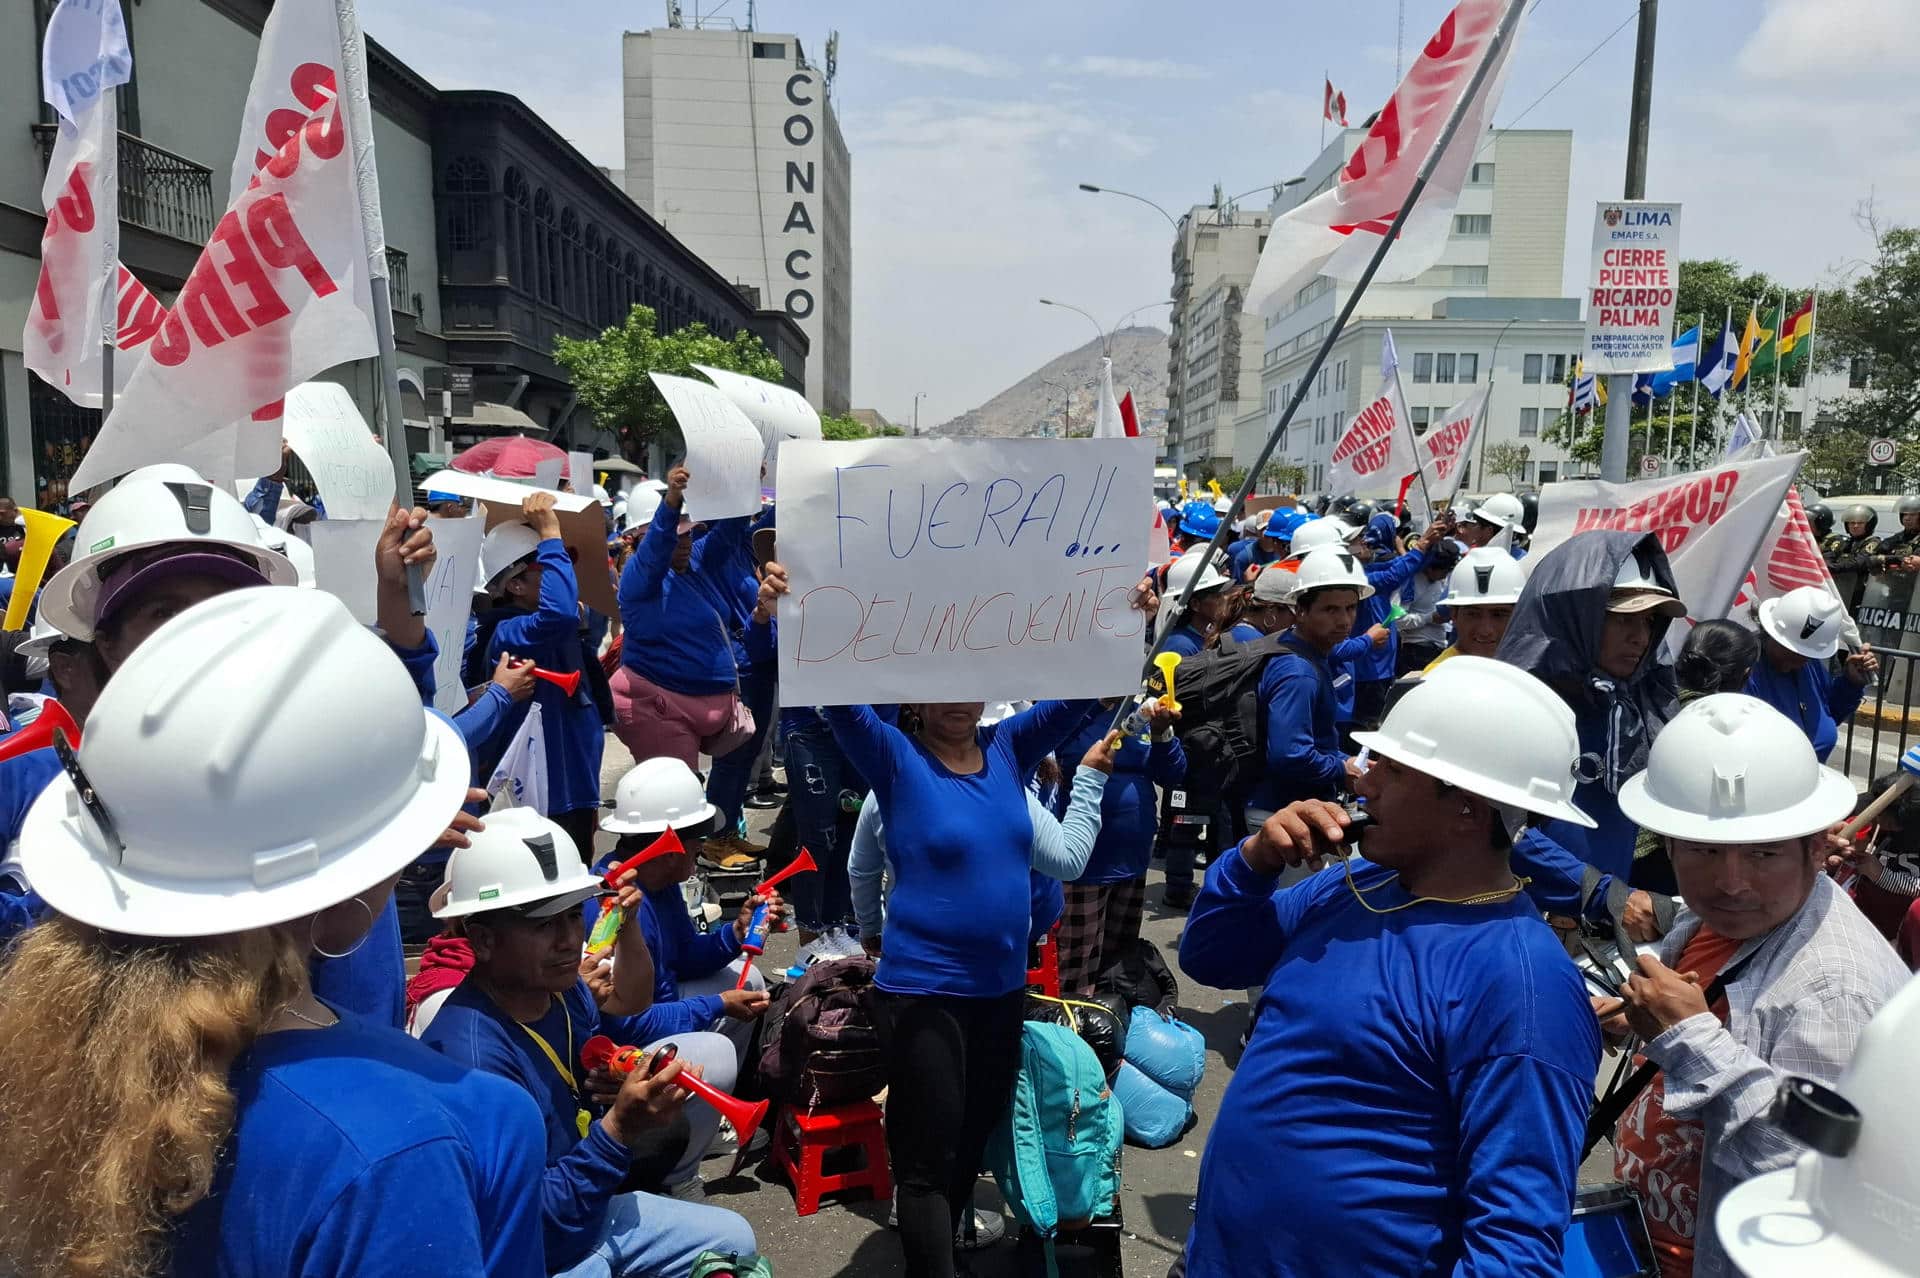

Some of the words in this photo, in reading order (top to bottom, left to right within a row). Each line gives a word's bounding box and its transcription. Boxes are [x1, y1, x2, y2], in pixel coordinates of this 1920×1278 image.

[783, 73, 816, 320] CONACO
[1624, 212, 1672, 226] LIMA
[1611, 231, 1644, 240] EMAPE
[1603, 249, 1666, 267] CIERRE
[1600, 269, 1669, 286] PUENTE
[1592, 288, 1673, 307] RICARDO
[1600, 309, 1660, 326] PALMA
[1650, 334, 1665, 342] POR
[1875, 444, 1889, 455] 40
[793, 565, 1144, 669] DELINCUENTES
